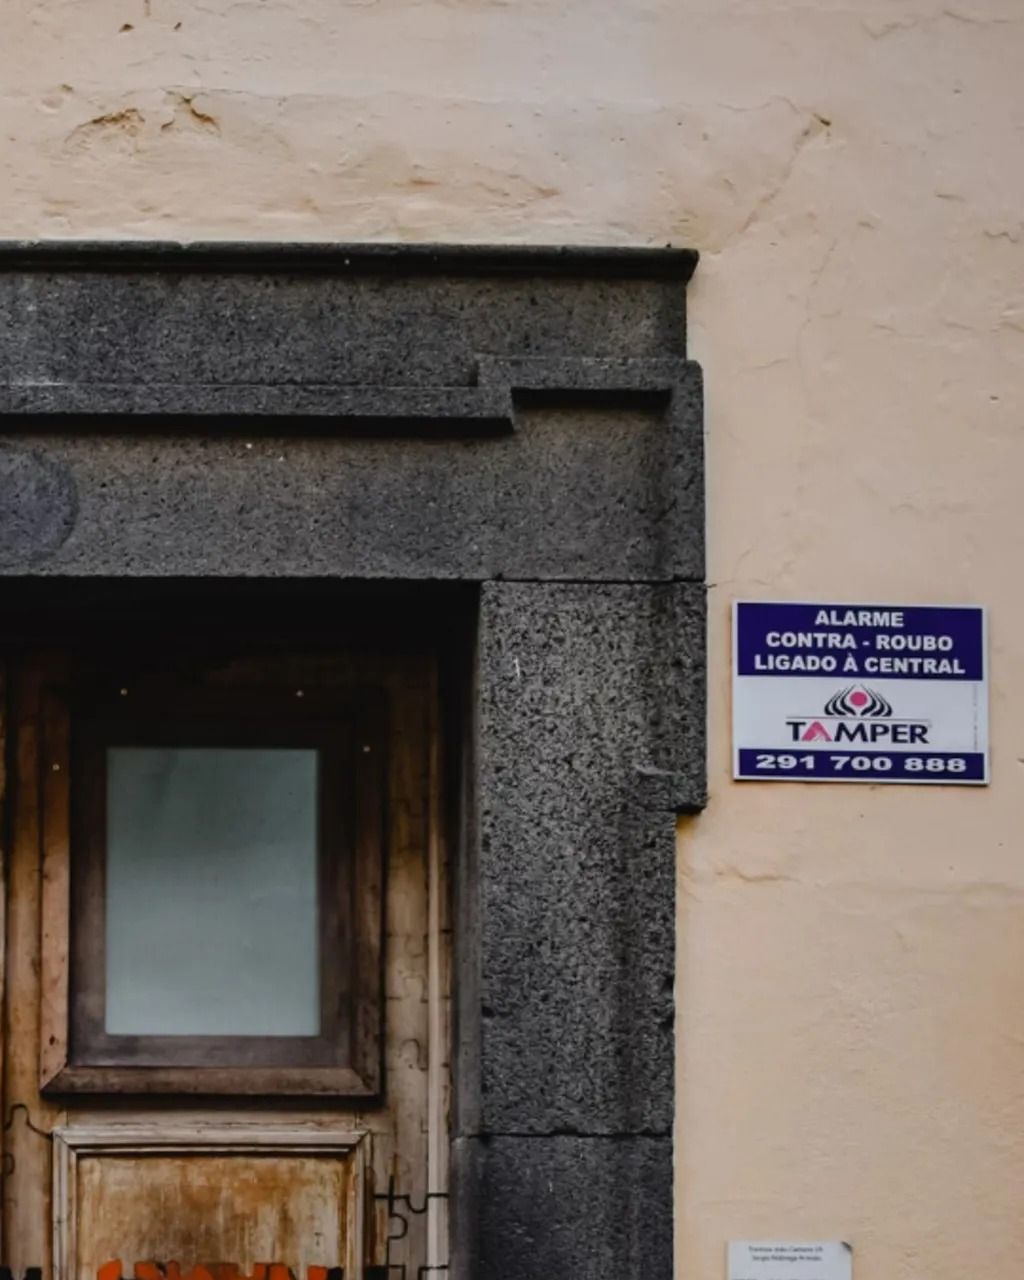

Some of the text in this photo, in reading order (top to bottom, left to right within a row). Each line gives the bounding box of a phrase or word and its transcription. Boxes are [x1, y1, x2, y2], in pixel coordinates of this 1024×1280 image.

[815, 610, 904, 627] ALARME
[766, 632, 857, 649] CONTRA
[876, 635, 953, 651] ROUBO
[754, 653, 966, 674] LIGADO À CENTRAL
[786, 721, 929, 744] TAMPER
[756, 755, 967, 773] 291 700 888
